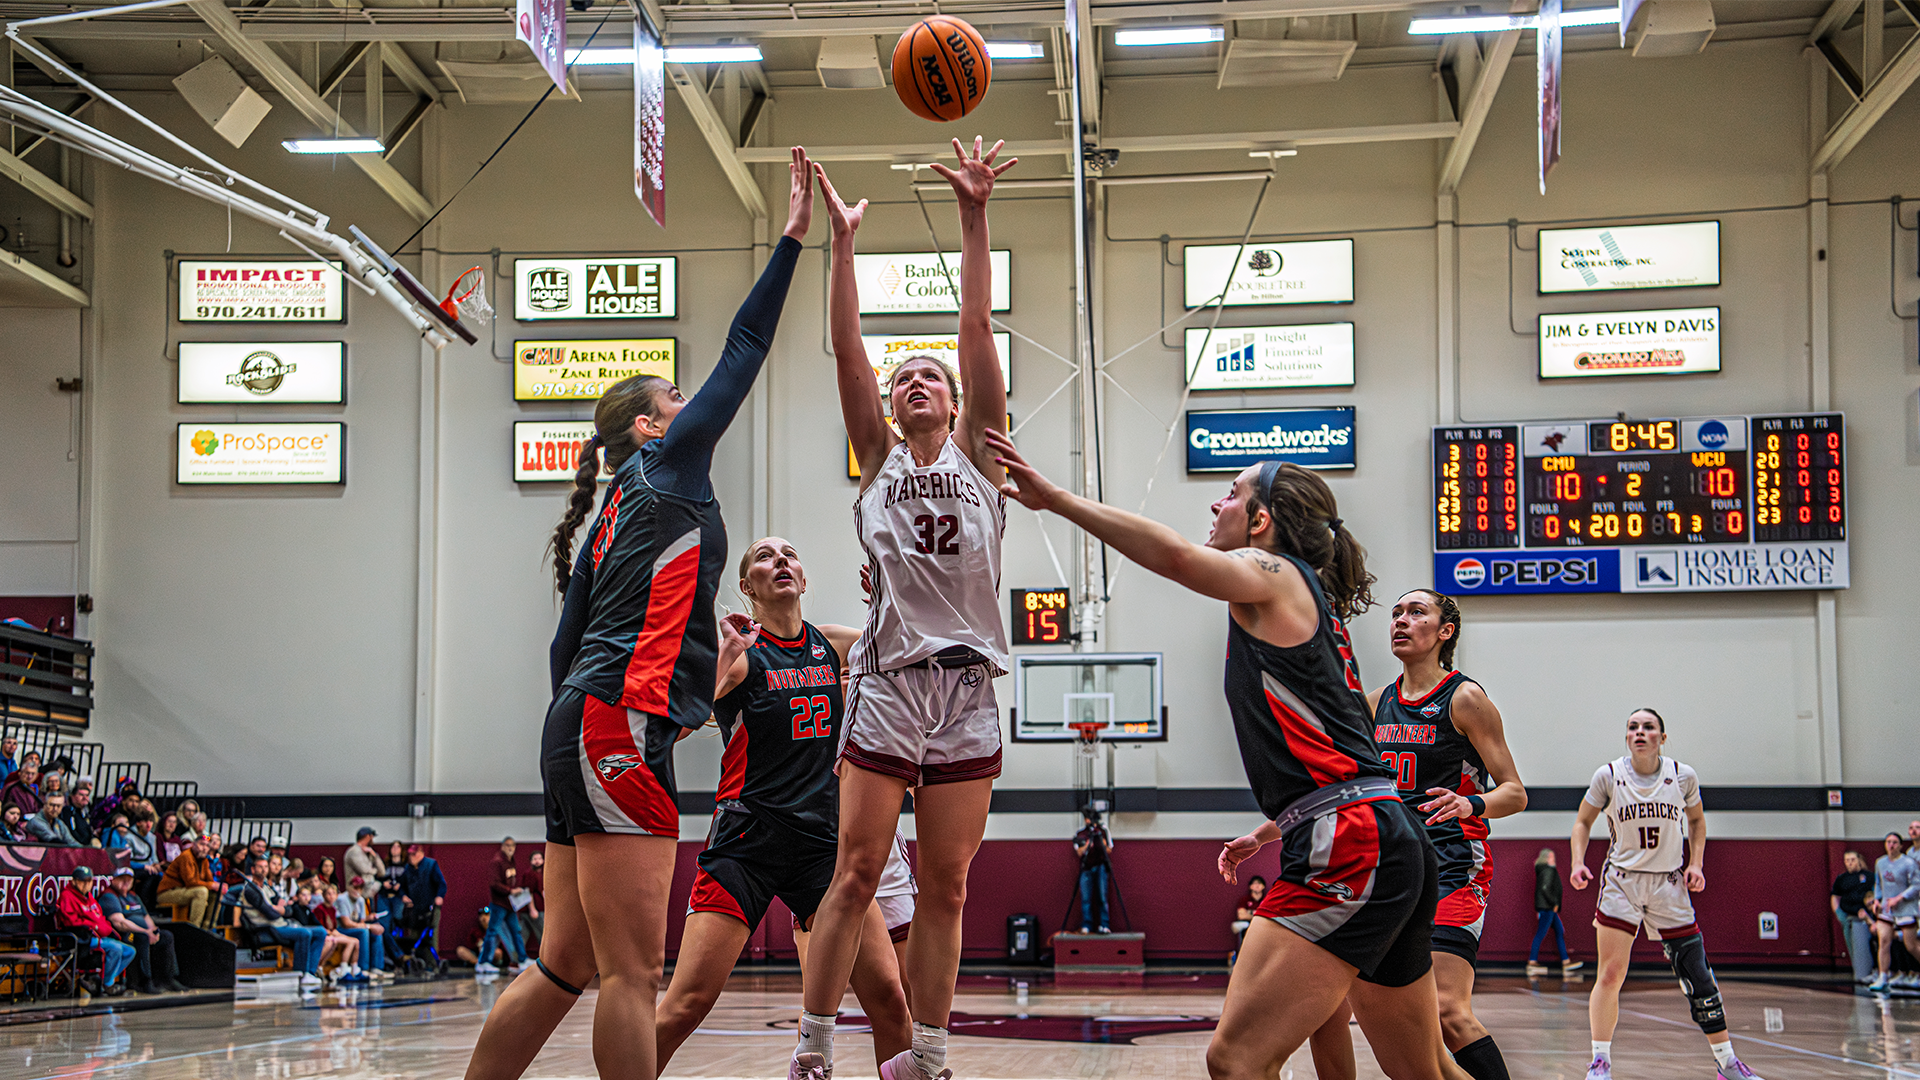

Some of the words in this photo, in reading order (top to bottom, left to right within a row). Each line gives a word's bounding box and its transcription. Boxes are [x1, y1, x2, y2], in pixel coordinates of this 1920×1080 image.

[946, 30, 978, 101] Wilson
[921, 54, 954, 106] NCAA
[197, 269, 326, 281] IMPACT
[589, 265, 658, 294] ALE
[905, 263, 947, 278] Bank
[950, 266, 960, 277] o
[531, 273, 568, 289] ALE
[905, 281, 959, 297] Colora
[531, 290, 568, 300] HOUSE
[197, 306, 326, 318] 970.241.7611
[590, 297, 658, 313] HOUSE
[1546, 325, 1571, 338] JIM
[1578, 324, 1589, 337] &
[1597, 321, 1657, 336] EVELYN
[1665, 318, 1715, 333] DAVIS
[885, 339, 959, 353] Fiest
[1264, 332, 1307, 344] Insight
[520, 347, 566, 365] CMU
[569, 350, 616, 363] ARENA
[622, 349, 670, 362] FLOOR
[1264, 346, 1323, 357] Financial
[226, 362, 297, 387] ROCKSLIDE
[561, 368, 591, 379] ZANE
[1264, 361, 1323, 372] Solutions
[532, 382, 605, 397] 970-261
[1763, 420, 1783, 430] PLYR
[1790, 419, 1804, 429] FLS
[1813, 418, 1829, 429] PTS
[1190, 424, 1348, 449] Groundworks
[1445, 430, 1463, 440] PLYR
[1469, 430, 1483, 439] FLS
[1488, 429, 1503, 439] PTS
[1610, 421, 1675, 452] 8:45
[1767, 434, 1780, 452] 0
[1797, 433, 1810, 451] 0
[1827, 432, 1840, 450] 0
[522, 441, 582, 471] LIQUO
[1449, 444, 1460, 461] 3
[1475, 443, 1488, 460] 0
[1504, 442, 1515, 460] 3
[1756, 452, 1780, 470] 20
[1797, 450, 1810, 468] 0
[1828, 450, 1840, 466] 7
[1443, 461, 1460, 478] 12
[1475, 460, 1488, 478] 0
[1504, 460, 1515, 477] 2
[1542, 456, 1575, 471] CMU
[1617, 461, 1651, 473] PERIOD
[1691, 452, 1726, 467] WCU
[1443, 479, 1460, 497] 15
[1481, 479, 1488, 495] 1
[1504, 477, 1516, 495] 0
[1555, 473, 1581, 501] 10
[1626, 473, 1642, 497] 2
[1708, 468, 1735, 497] 10
[1756, 470, 1781, 488] 21
[1797, 469, 1810, 487] 0
[1827, 468, 1840, 486] 0
[1438, 496, 1461, 514] 23
[1476, 496, 1488, 513] 0
[1504, 495, 1516, 513] 0
[1757, 488, 1781, 506] 22
[1803, 488, 1811, 503] 1
[1829, 486, 1841, 504] 3
[1530, 503, 1559, 514] FOULS
[1592, 502, 1616, 513] PLYR
[1622, 501, 1647, 513] FOUL
[1656, 500, 1675, 511] PTS
[1711, 498, 1742, 510] FOULS
[1757, 506, 1782, 524] 23
[1798, 505, 1811, 524] 0
[1828, 505, 1841, 523] 0
[1439, 515, 1461, 532] 32
[1476, 514, 1489, 531] 0
[1504, 513, 1516, 531] 5
[1544, 515, 1560, 539] 0
[1568, 518, 1581, 535] 4
[1589, 514, 1620, 538] 20
[1627, 513, 1643, 538] 0
[1667, 513, 1682, 535] 7
[1691, 514, 1702, 533] 3
[1727, 511, 1743, 535] 0
[914, 515, 960, 555] 32
[1684, 548, 1757, 568] HOME
[1765, 547, 1834, 567] LOAN
[1456, 569, 1484, 577] PEPSI
[1491, 558, 1598, 585] PEPSI
[1687, 566, 1833, 586] INSURANCE
[1025, 592, 1066, 611] 8:44
[1028, 610, 1059, 641] 15
[765, 664, 837, 691] MOUNTAINEERS
[790, 694, 832, 740] 22
[1374, 723, 1438, 745] MOUNTAINEERS
[1617, 803, 1679, 822] MAVERICKS
[1638, 826, 1660, 849] 15
